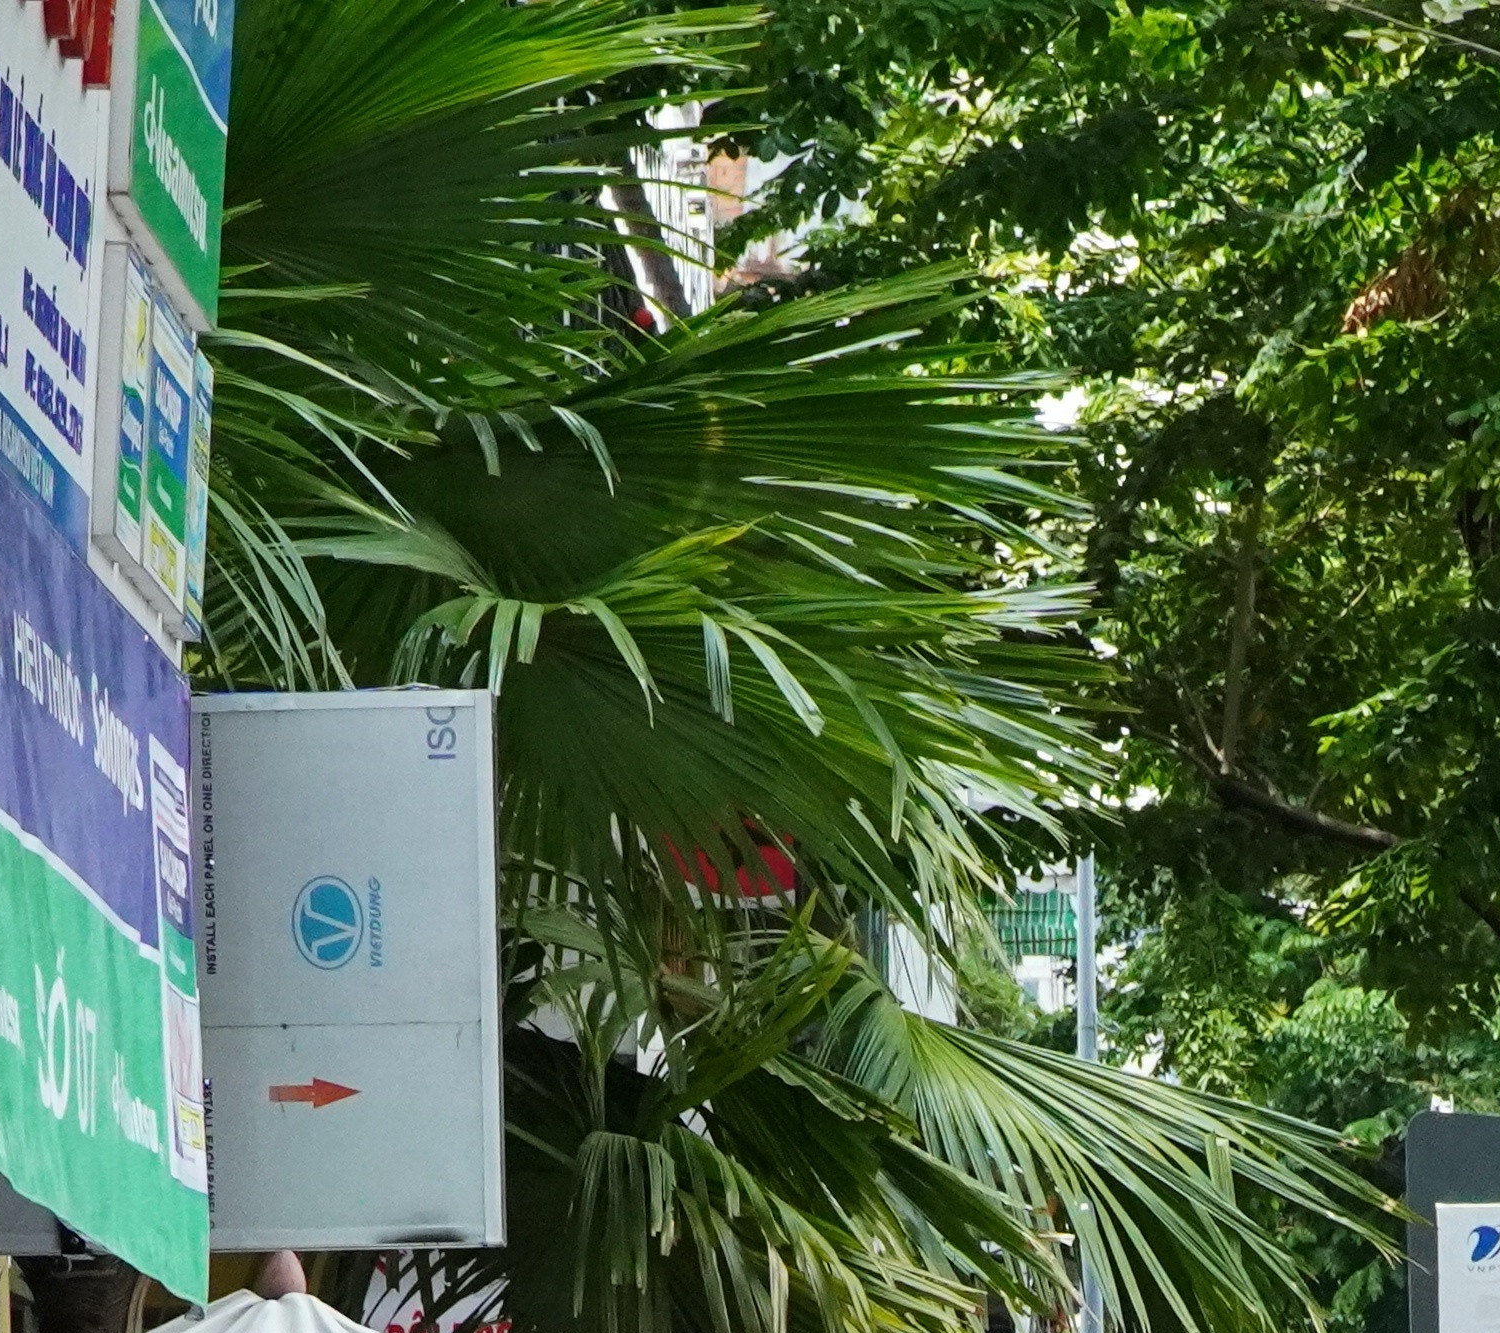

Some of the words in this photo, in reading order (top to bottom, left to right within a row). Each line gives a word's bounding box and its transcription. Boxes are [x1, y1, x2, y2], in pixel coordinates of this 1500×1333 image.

[203, 786, 212, 812] ONE
[203, 815, 213, 833] ON
[205, 880, 215, 921] EACH
[368, 875, 383, 968] VIETDUNG
